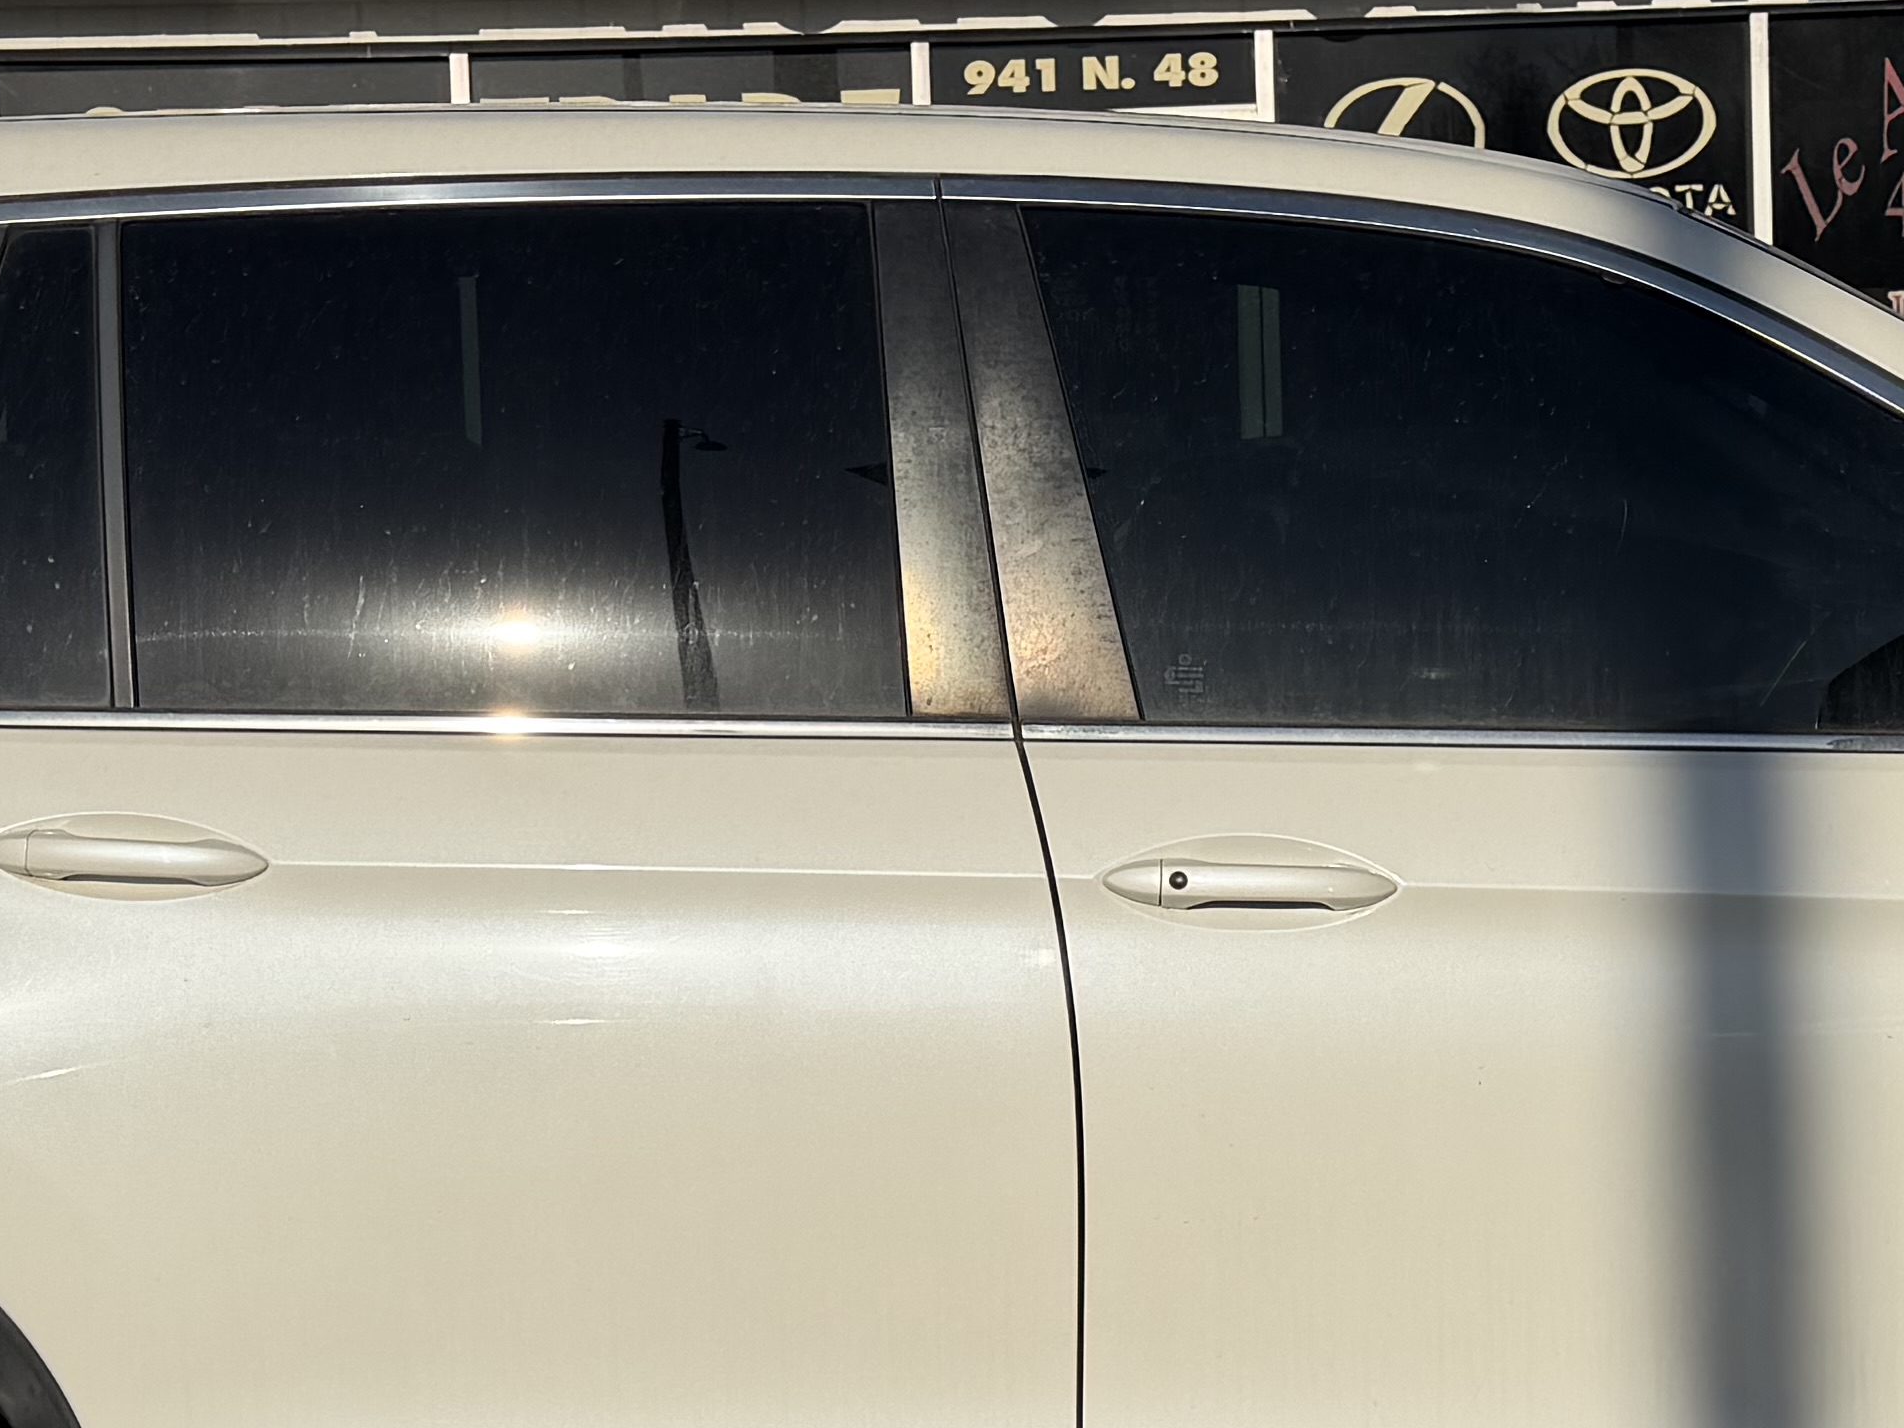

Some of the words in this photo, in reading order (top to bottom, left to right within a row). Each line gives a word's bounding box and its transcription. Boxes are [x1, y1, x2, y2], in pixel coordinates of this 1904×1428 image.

[963, 57, 1057, 96] 941
[1081, 55, 1137, 91] N.
[1153, 51, 1220, 88] 48
[1780, 137, 1866, 242] Le
